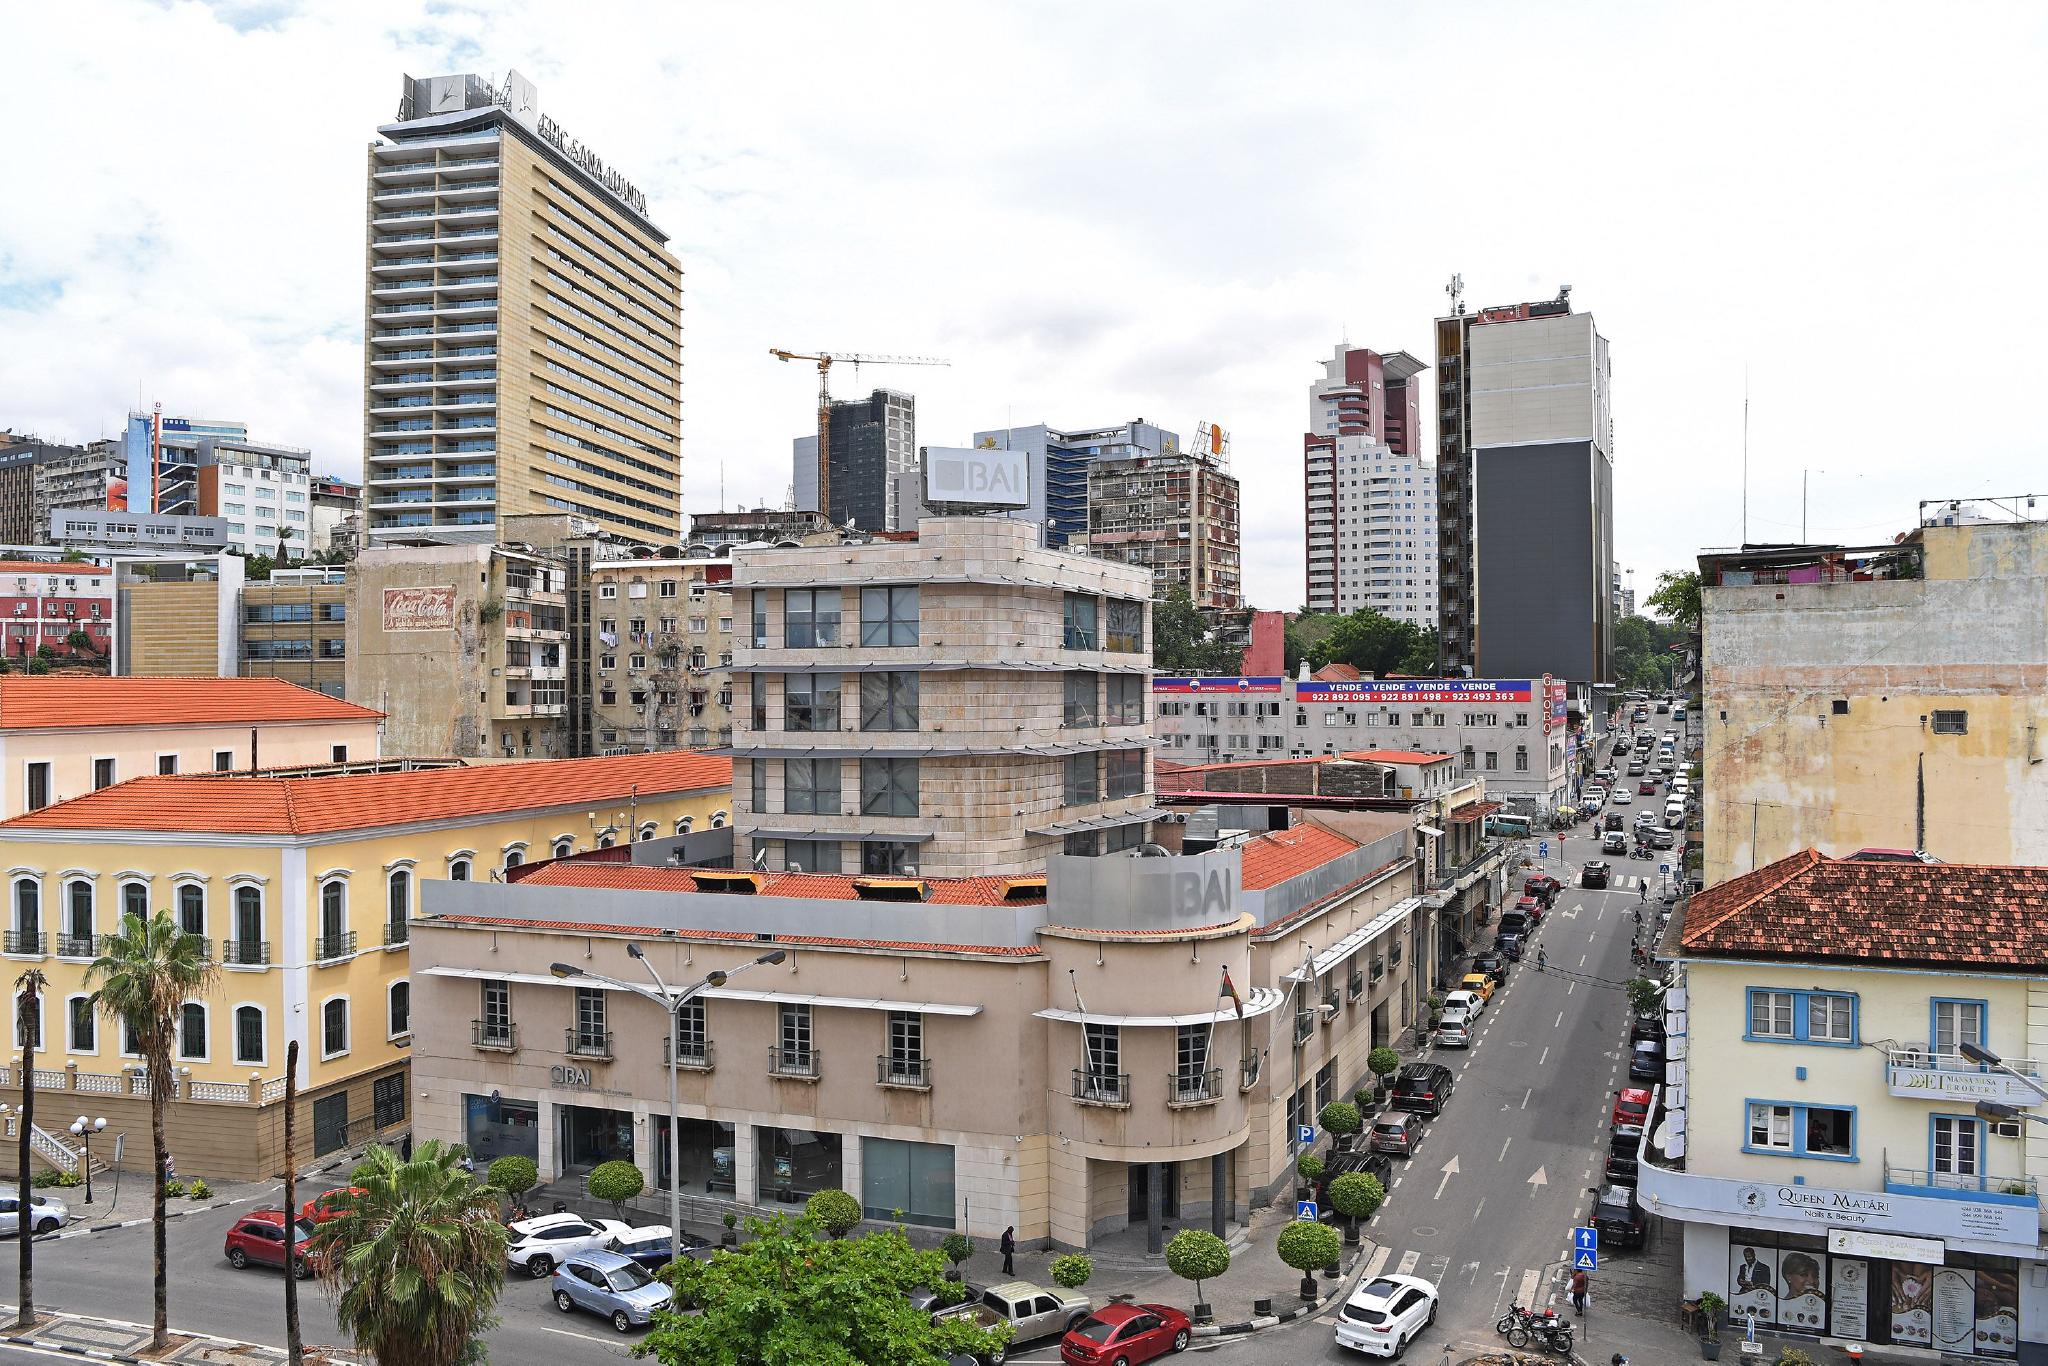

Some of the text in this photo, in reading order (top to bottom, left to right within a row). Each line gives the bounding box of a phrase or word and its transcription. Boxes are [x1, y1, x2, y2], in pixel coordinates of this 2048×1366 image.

[968, 461, 1020, 494] BAI
[1312, 693, 1329, 701] 922
[1332, 693, 1350, 701] 892
[1543, 676, 1551, 733] GLOBO
[1175, 868, 1231, 917] BAI
[564, 1067, 591, 1086] BAI
[1301, 1127, 1312, 1140] P
[1778, 1187, 1890, 1211] QUEEN MATÁRI
[1804, 1210, 1824, 1218] Nails
[1836, 1213, 1866, 1223] Beauty
